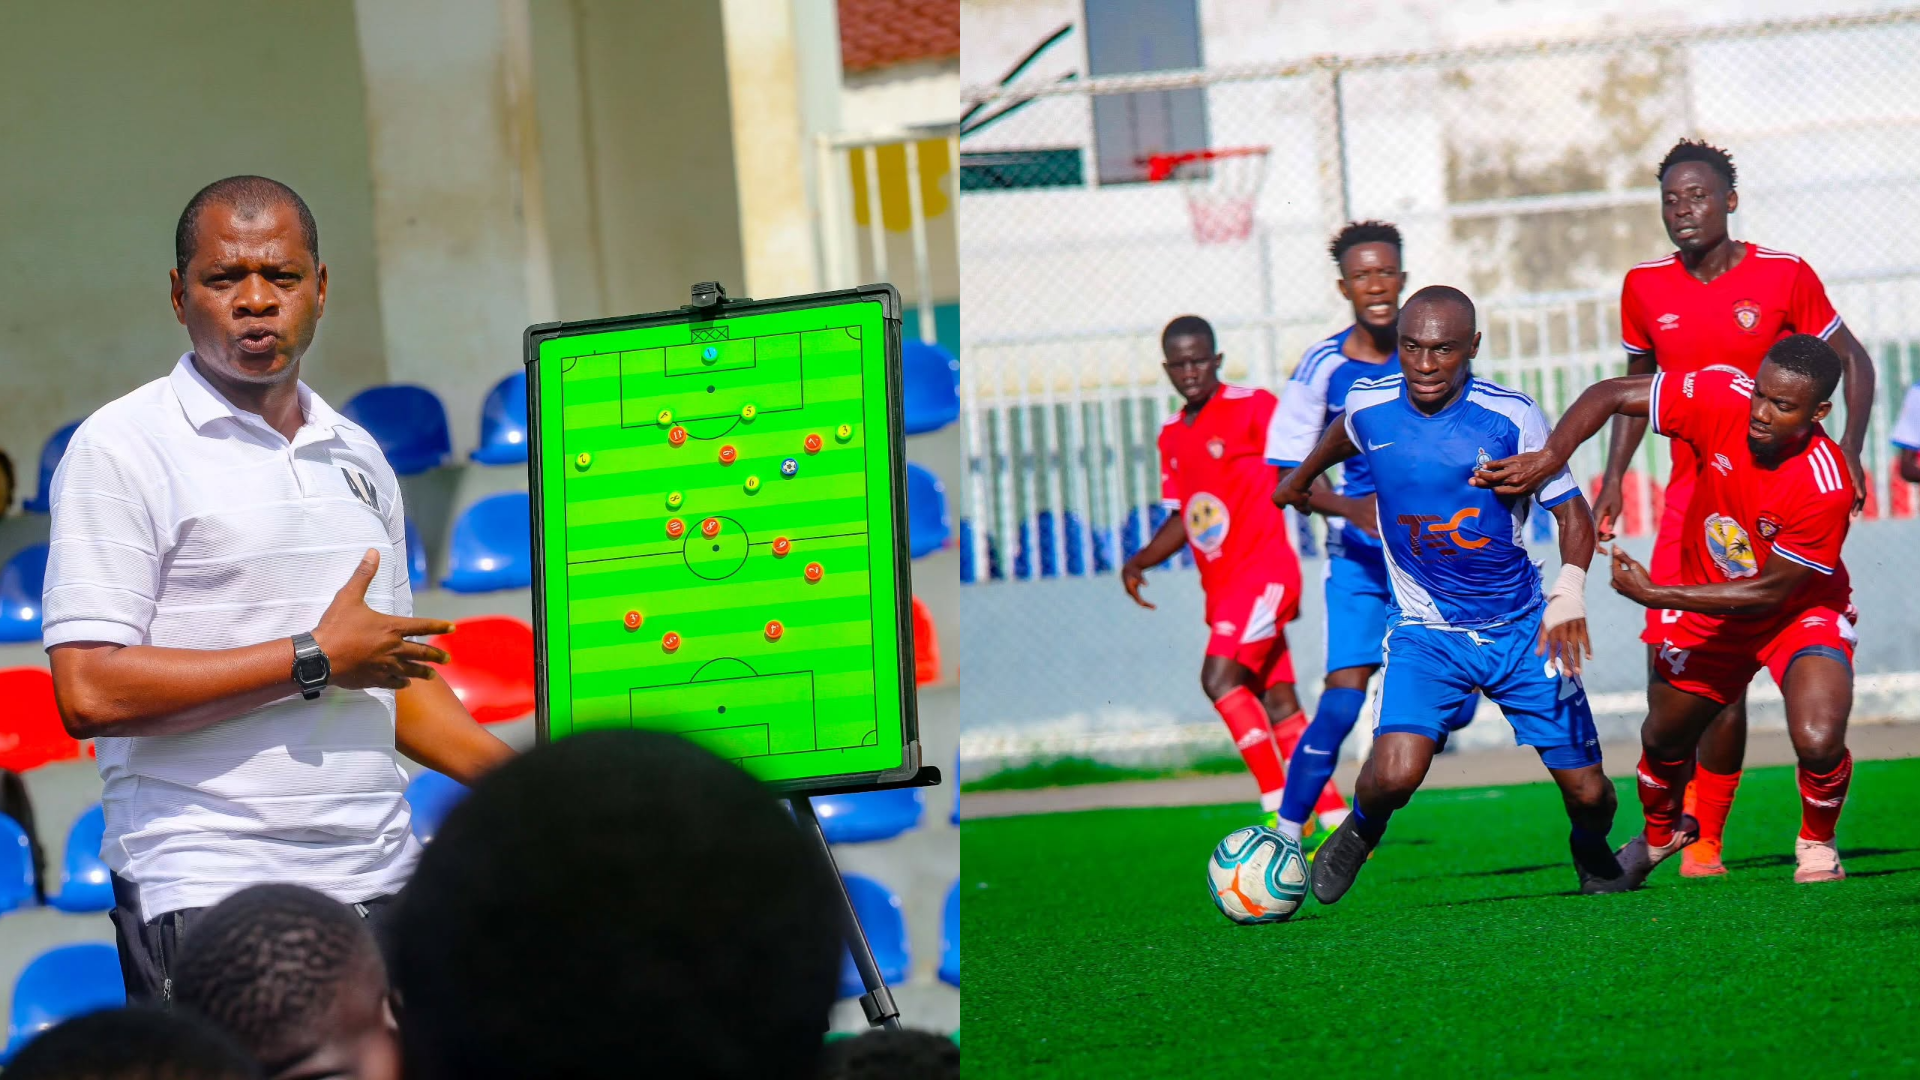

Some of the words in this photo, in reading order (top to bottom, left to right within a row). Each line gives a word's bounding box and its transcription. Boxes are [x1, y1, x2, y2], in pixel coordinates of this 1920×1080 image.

[745, 405, 752, 416] 5
[841, 424, 849, 436] 3
[807, 436, 817, 447] 7
[706, 521, 716, 531] 8
